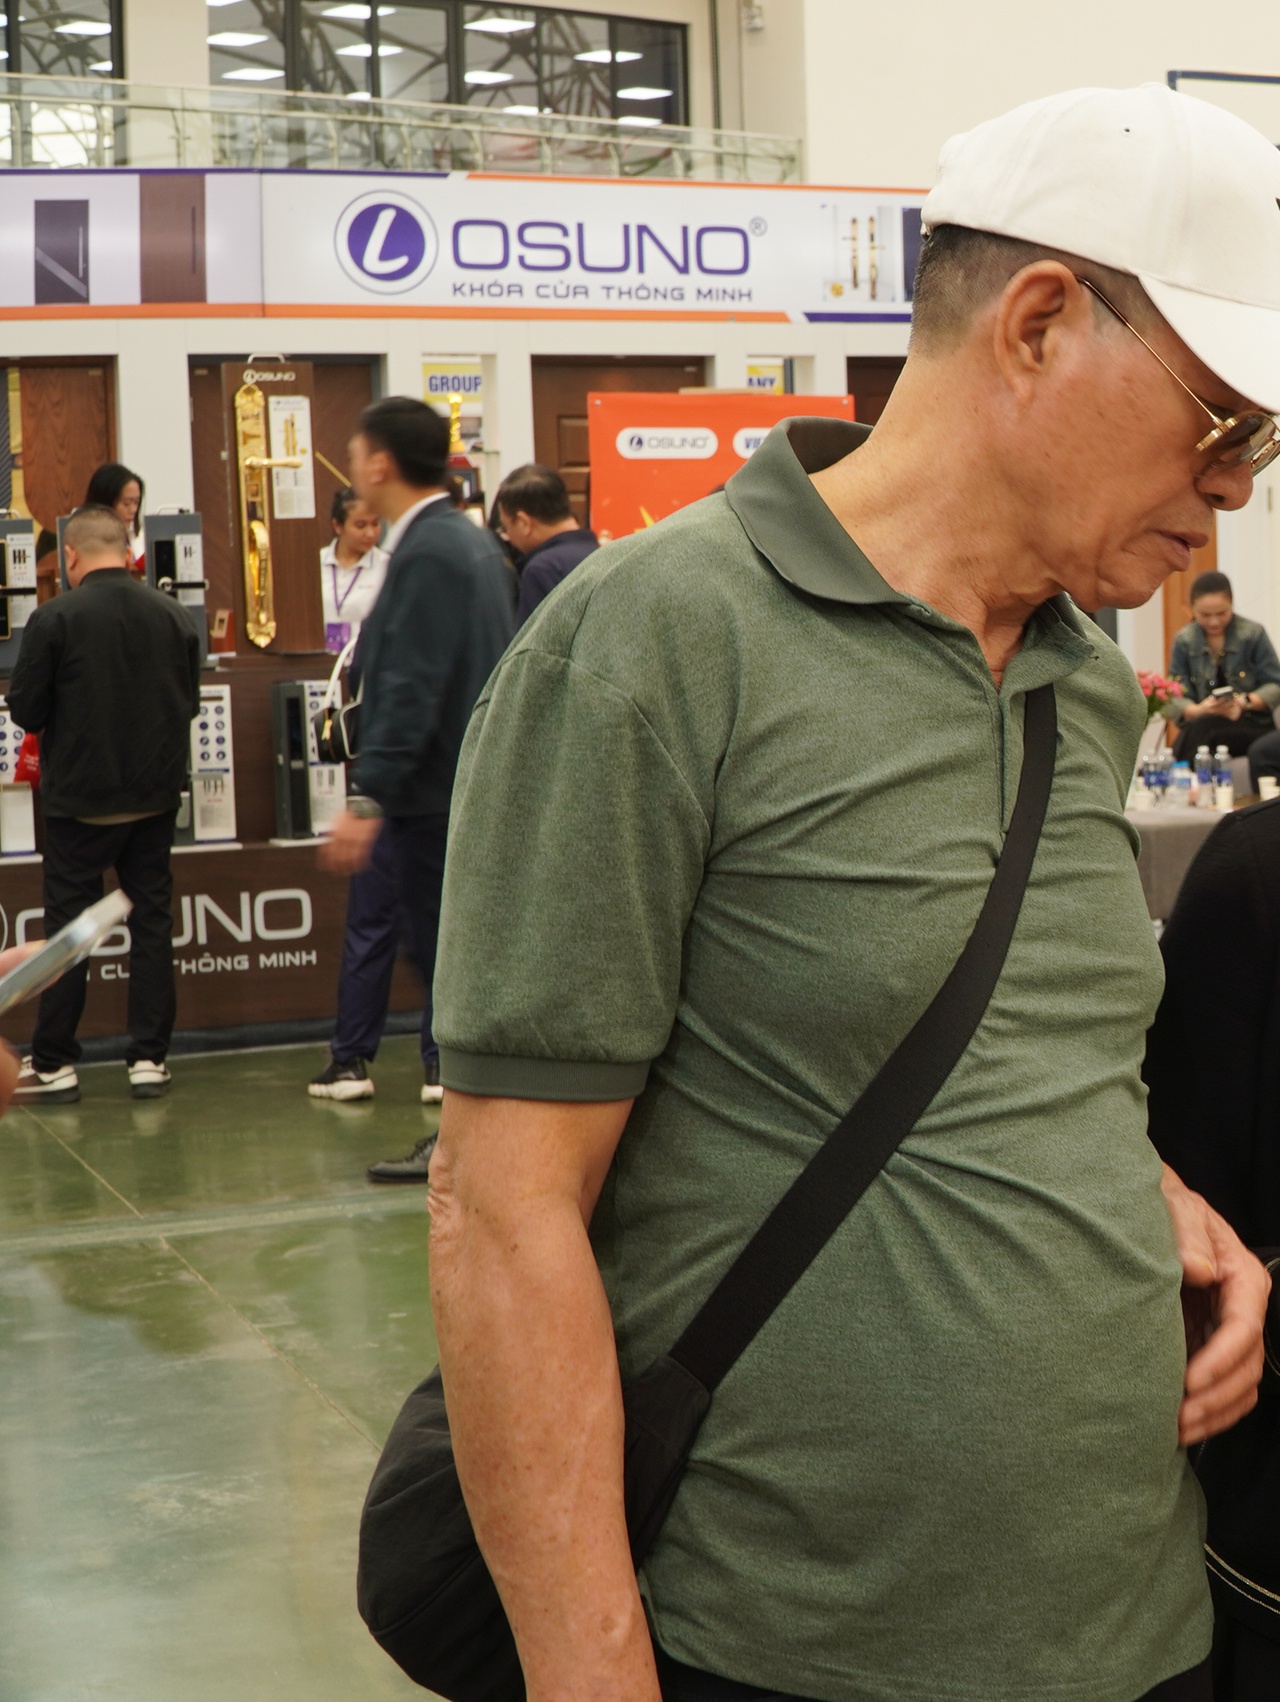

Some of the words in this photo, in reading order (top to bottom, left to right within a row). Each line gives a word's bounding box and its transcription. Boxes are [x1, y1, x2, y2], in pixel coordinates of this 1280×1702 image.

[452, 219, 749, 276] OSUNO
[696, 286, 752, 302] MINH
[647, 436, 708, 450] OSUNO
[259, 949, 317, 969] MINH
